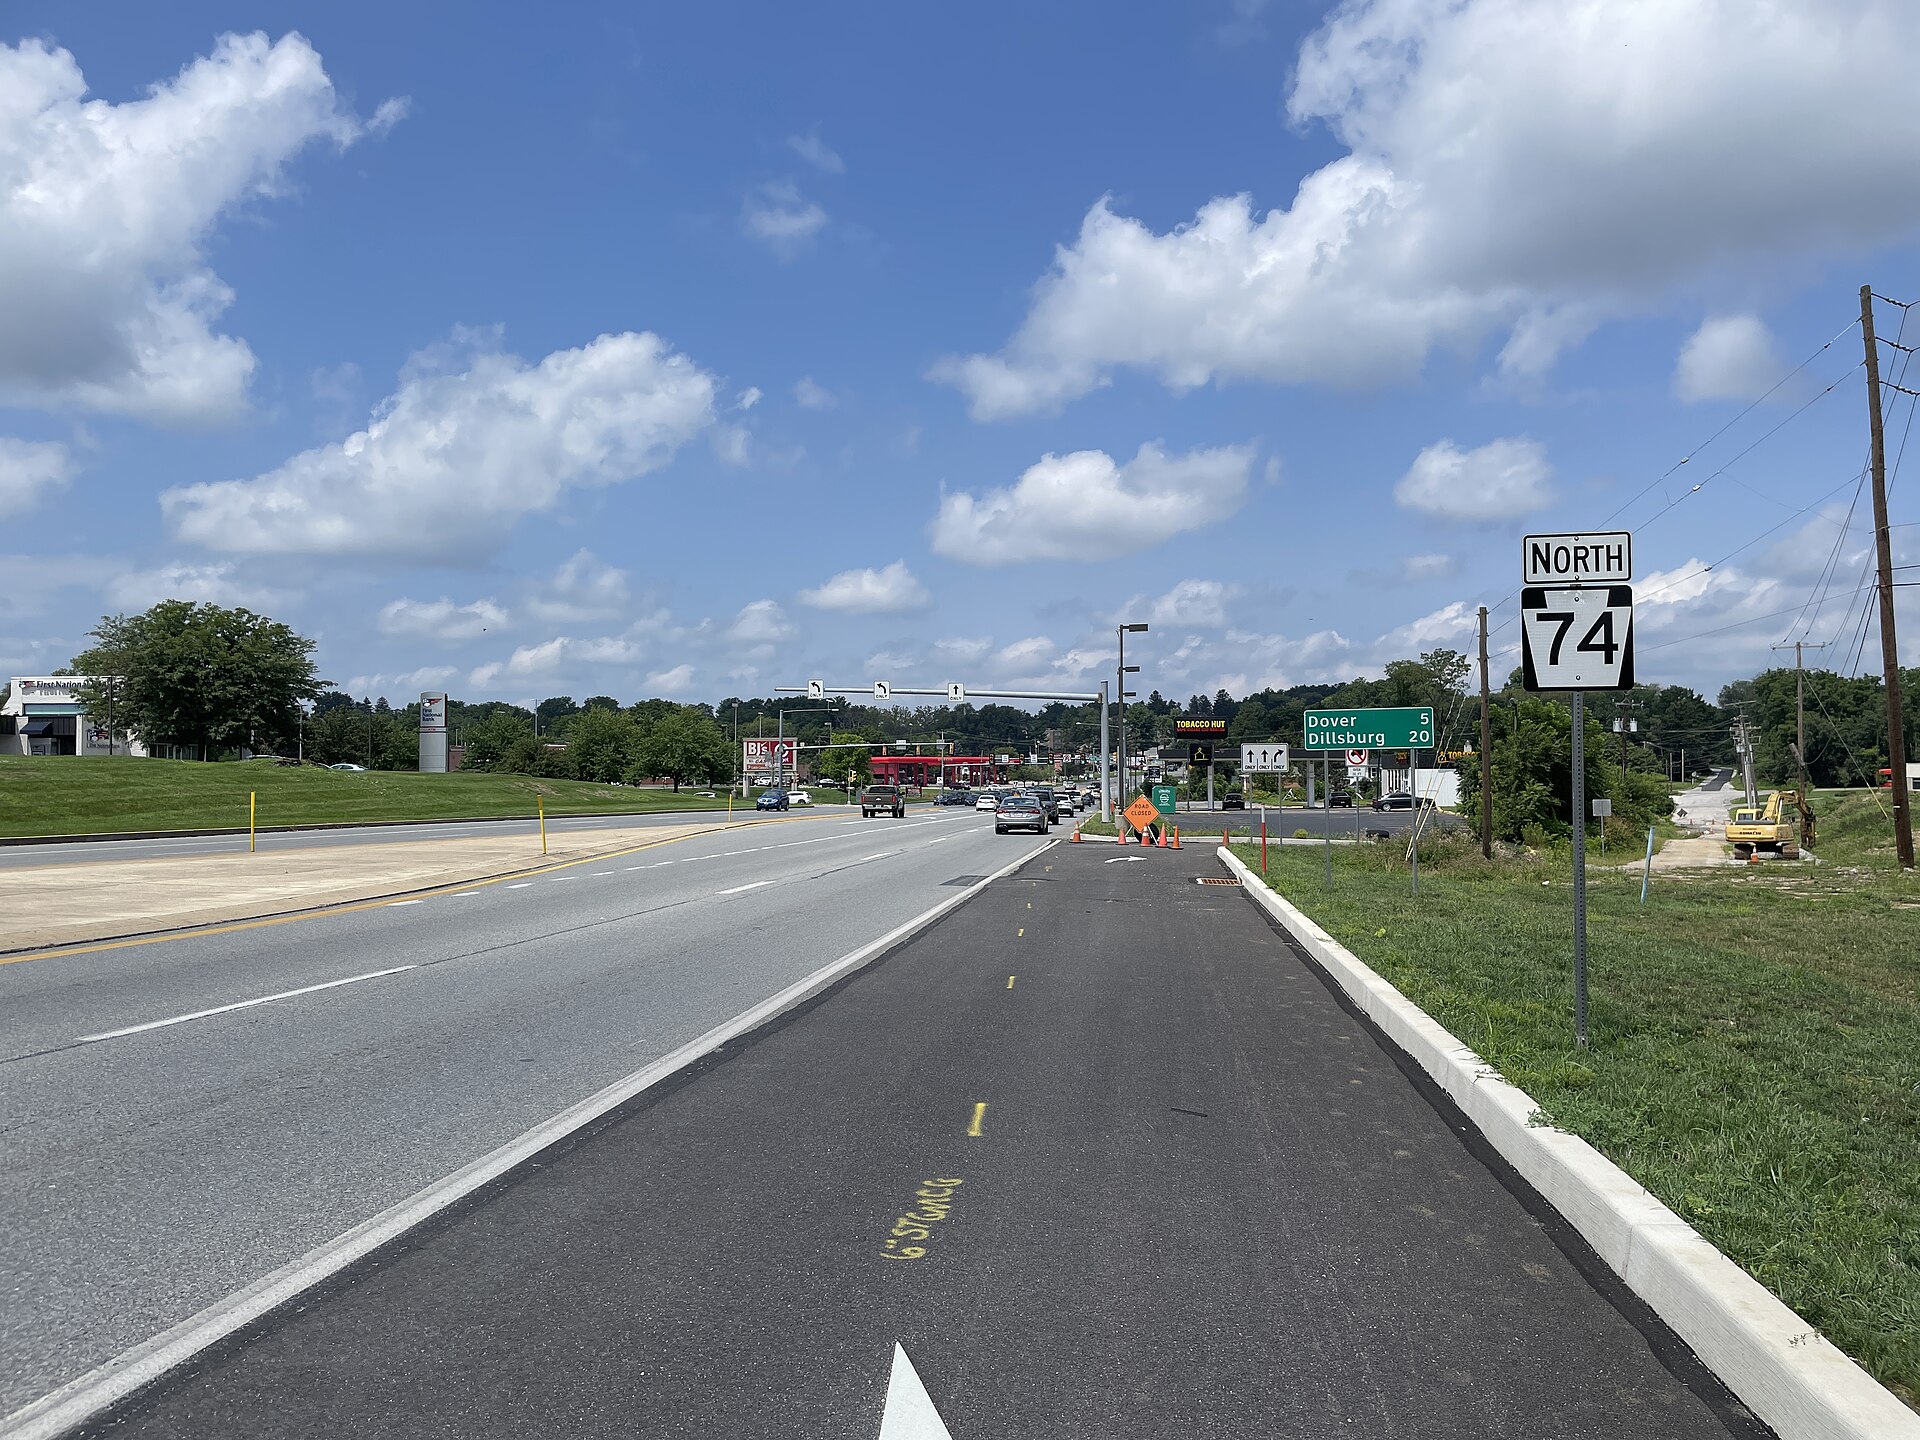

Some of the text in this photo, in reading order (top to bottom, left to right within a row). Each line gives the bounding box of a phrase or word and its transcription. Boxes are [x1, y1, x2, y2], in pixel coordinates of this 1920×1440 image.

[1532, 542, 1622, 574] NORTH
[1536, 611, 1619, 665] 74
[36, 680, 54, 688] First
[1176, 720, 1226, 728] TOBACCO HUT
[1308, 713, 1429, 728] Dover 5
[1308, 730, 1430, 746] Dillsburg 20
[748, 742, 768, 756] BJ's
